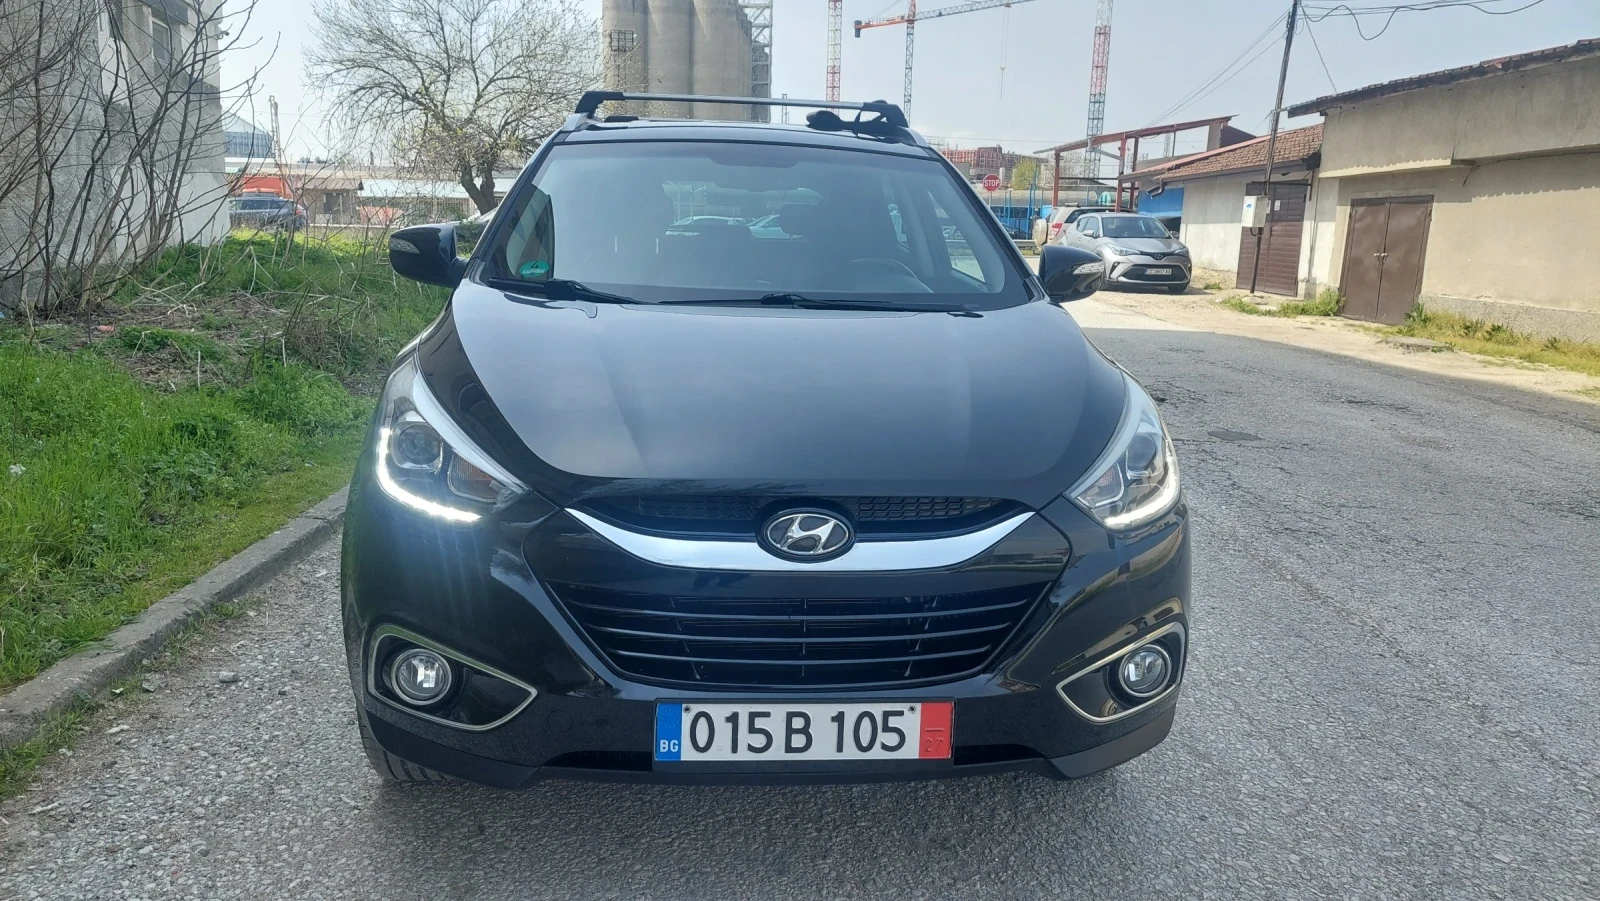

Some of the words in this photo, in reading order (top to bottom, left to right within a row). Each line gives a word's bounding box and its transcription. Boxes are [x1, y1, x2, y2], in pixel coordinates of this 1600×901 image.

[984, 179, 1000, 187] STOP
[830, 710, 907, 753] 105
[659, 739, 679, 753] BG
